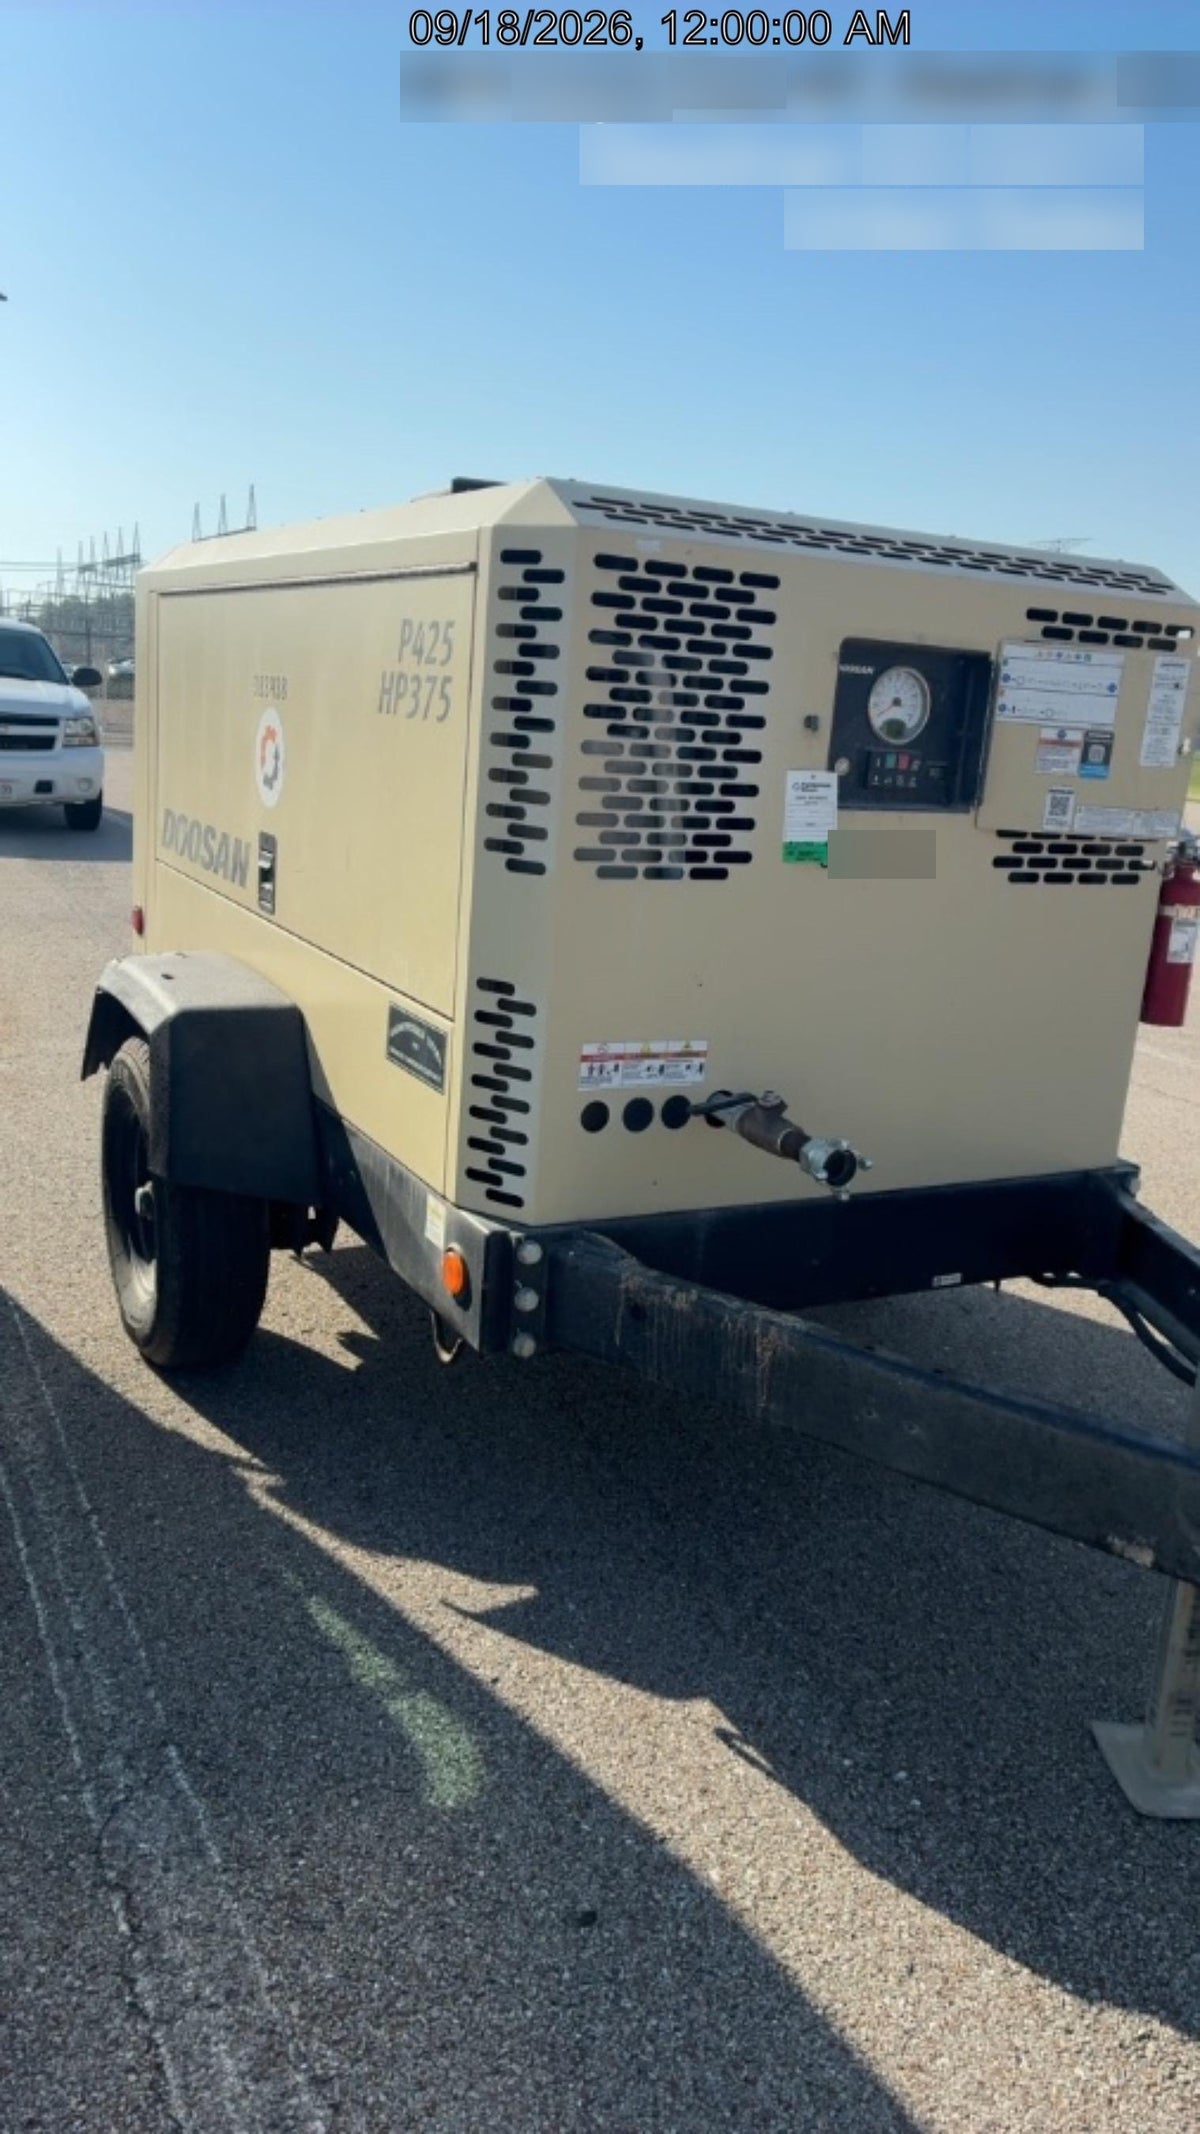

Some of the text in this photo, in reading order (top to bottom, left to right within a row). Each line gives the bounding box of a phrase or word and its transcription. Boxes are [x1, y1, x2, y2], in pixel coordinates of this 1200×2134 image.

[397, 618, 456, 667] P425
[378, 670, 453, 723] HP375
[161, 807, 250, 889] DOOSAN
